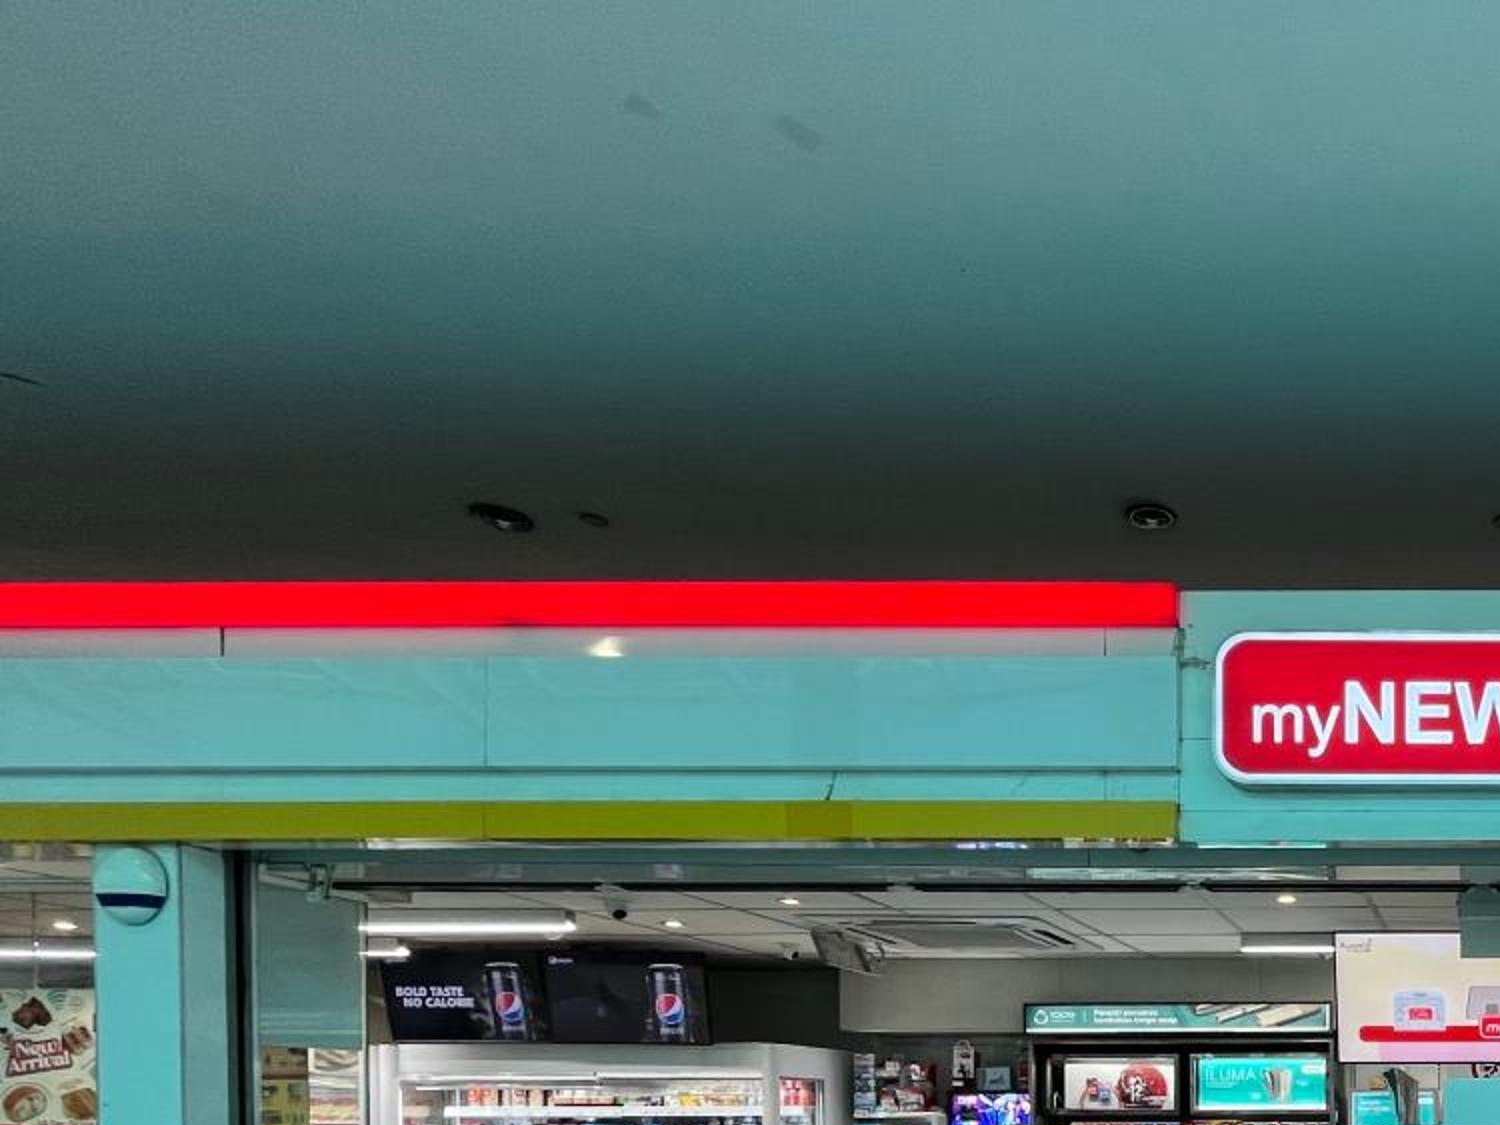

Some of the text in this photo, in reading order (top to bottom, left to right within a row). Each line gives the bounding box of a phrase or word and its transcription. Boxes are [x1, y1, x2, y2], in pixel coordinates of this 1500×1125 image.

[395, 986, 464, 997] BOLD TASTE
[403, 997, 422, 1008] NO
[9, 1051, 70, 1072] Arrival
